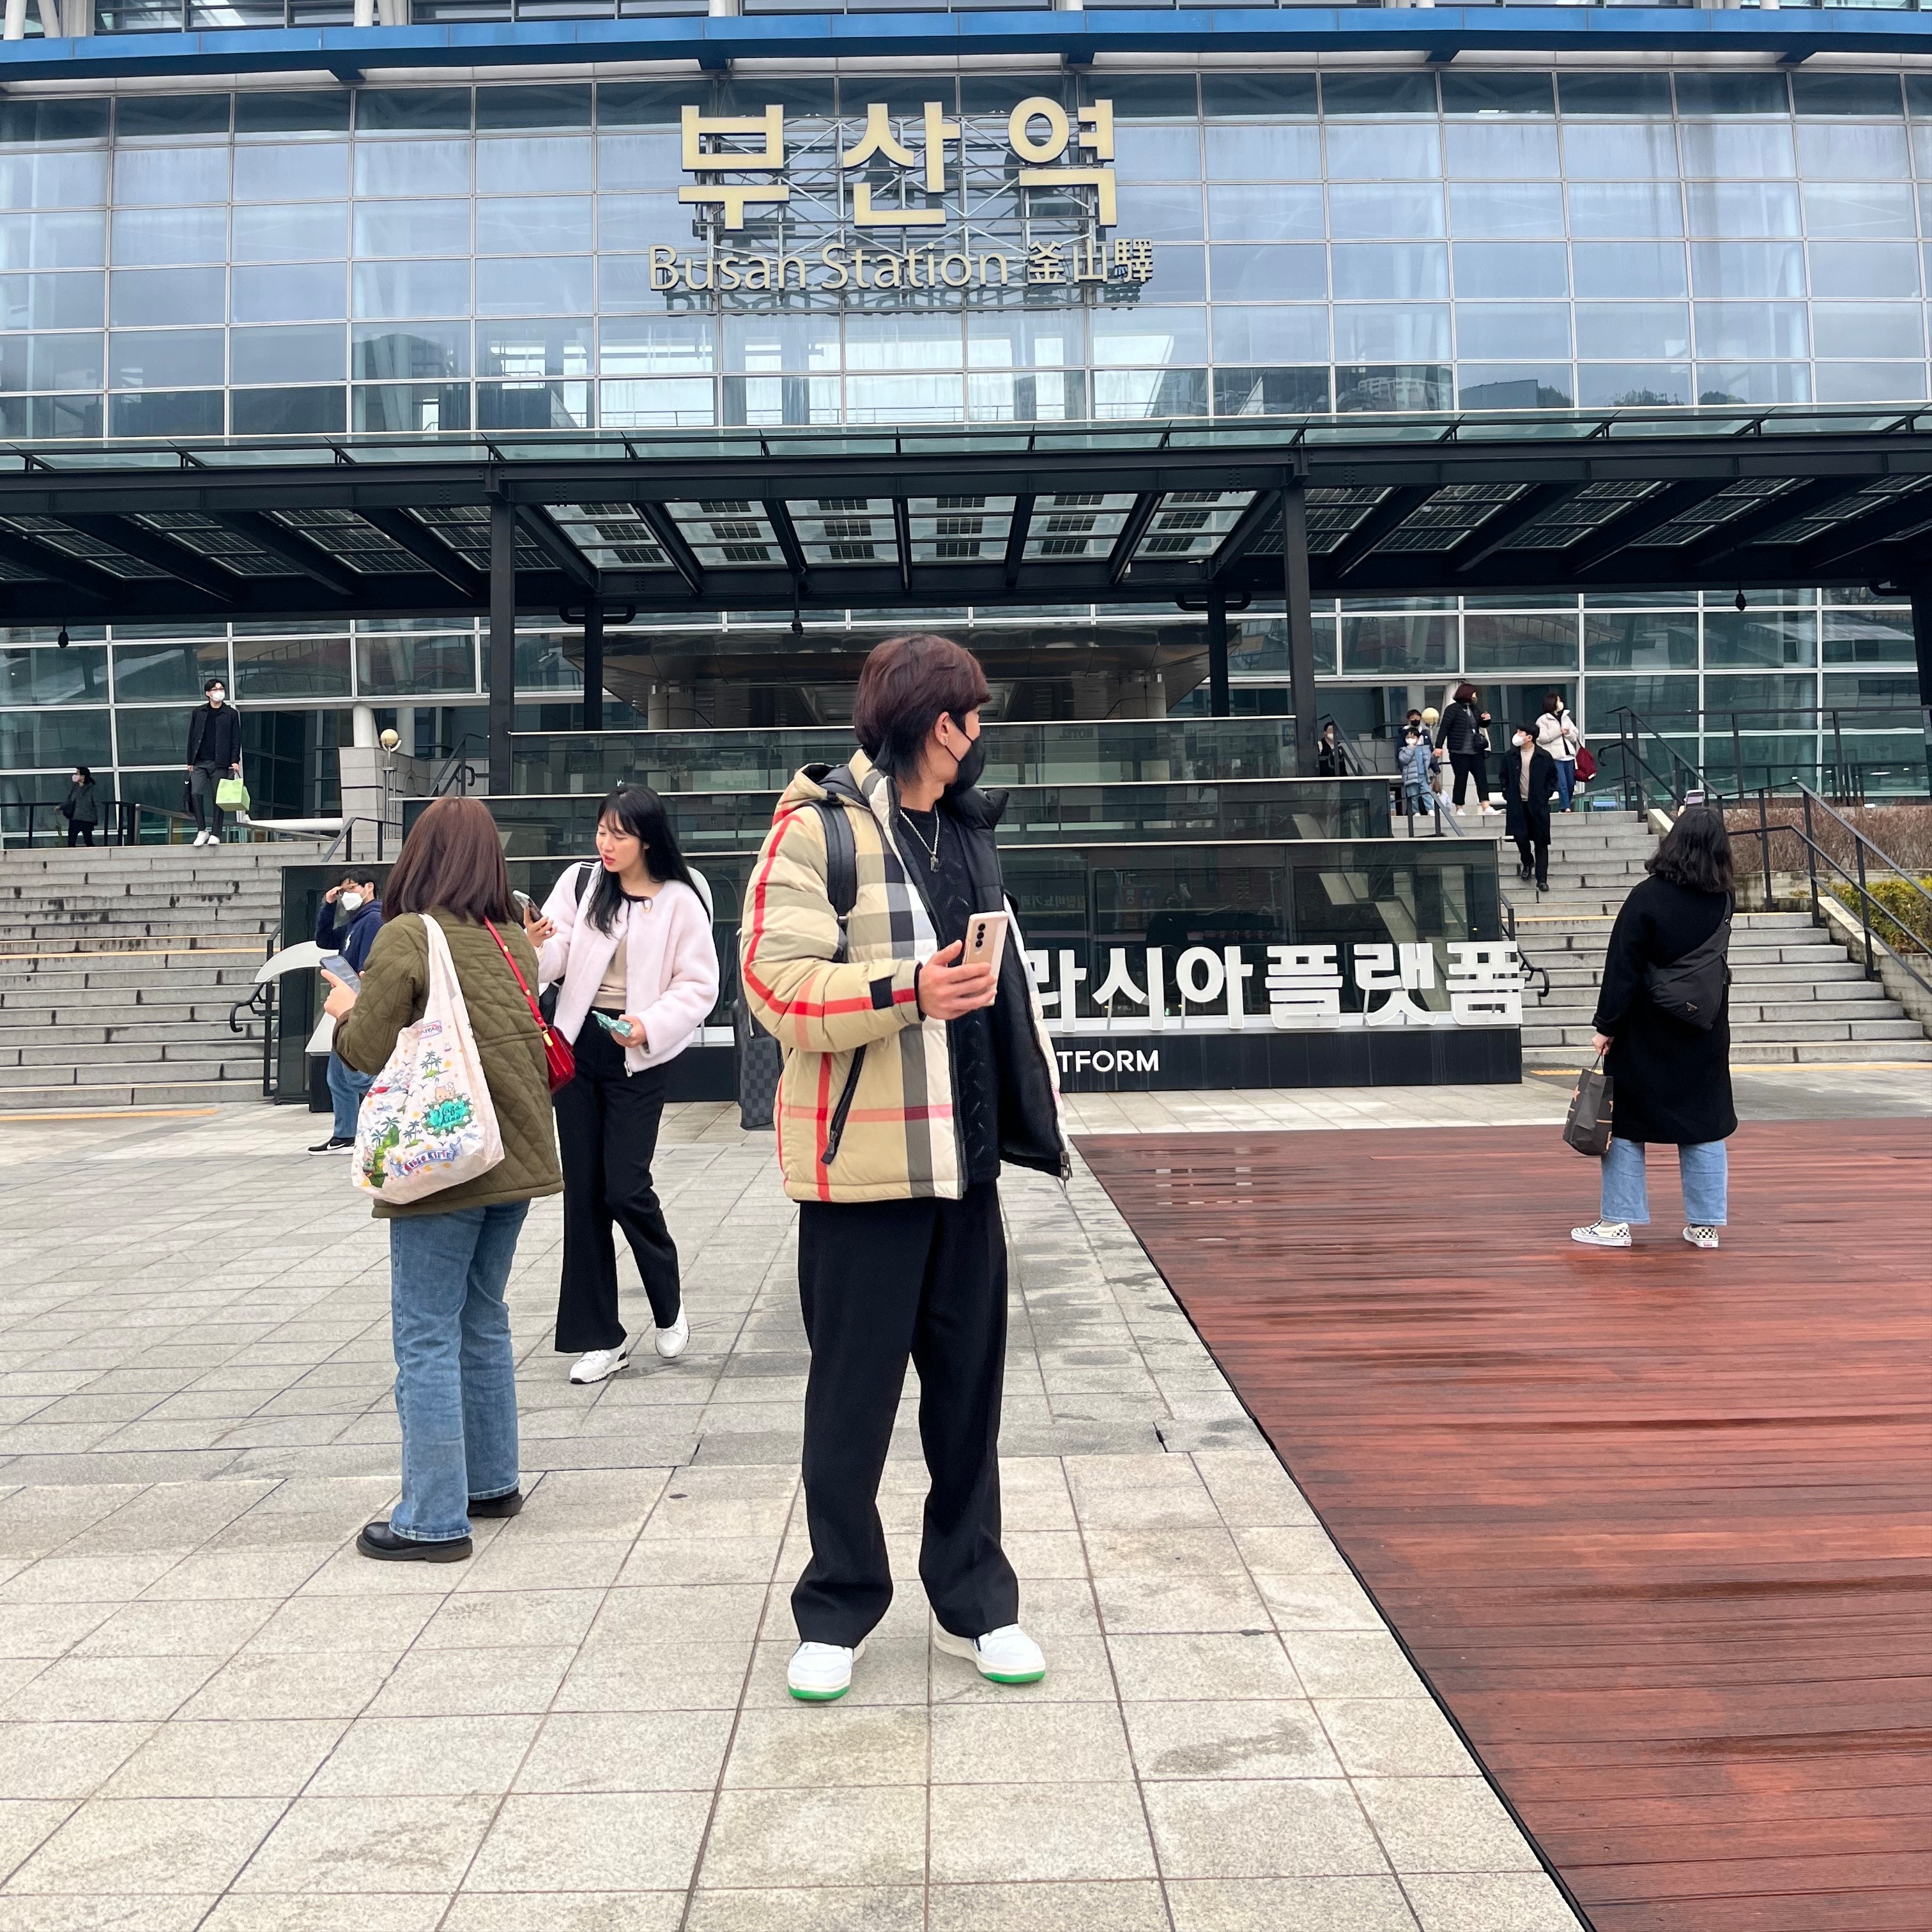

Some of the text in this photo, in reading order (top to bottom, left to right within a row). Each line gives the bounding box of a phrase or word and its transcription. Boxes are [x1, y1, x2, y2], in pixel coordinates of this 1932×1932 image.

[678, 96, 1117, 230] 부산역
[649, 238, 1154, 291] Busan Station 釜山驛
